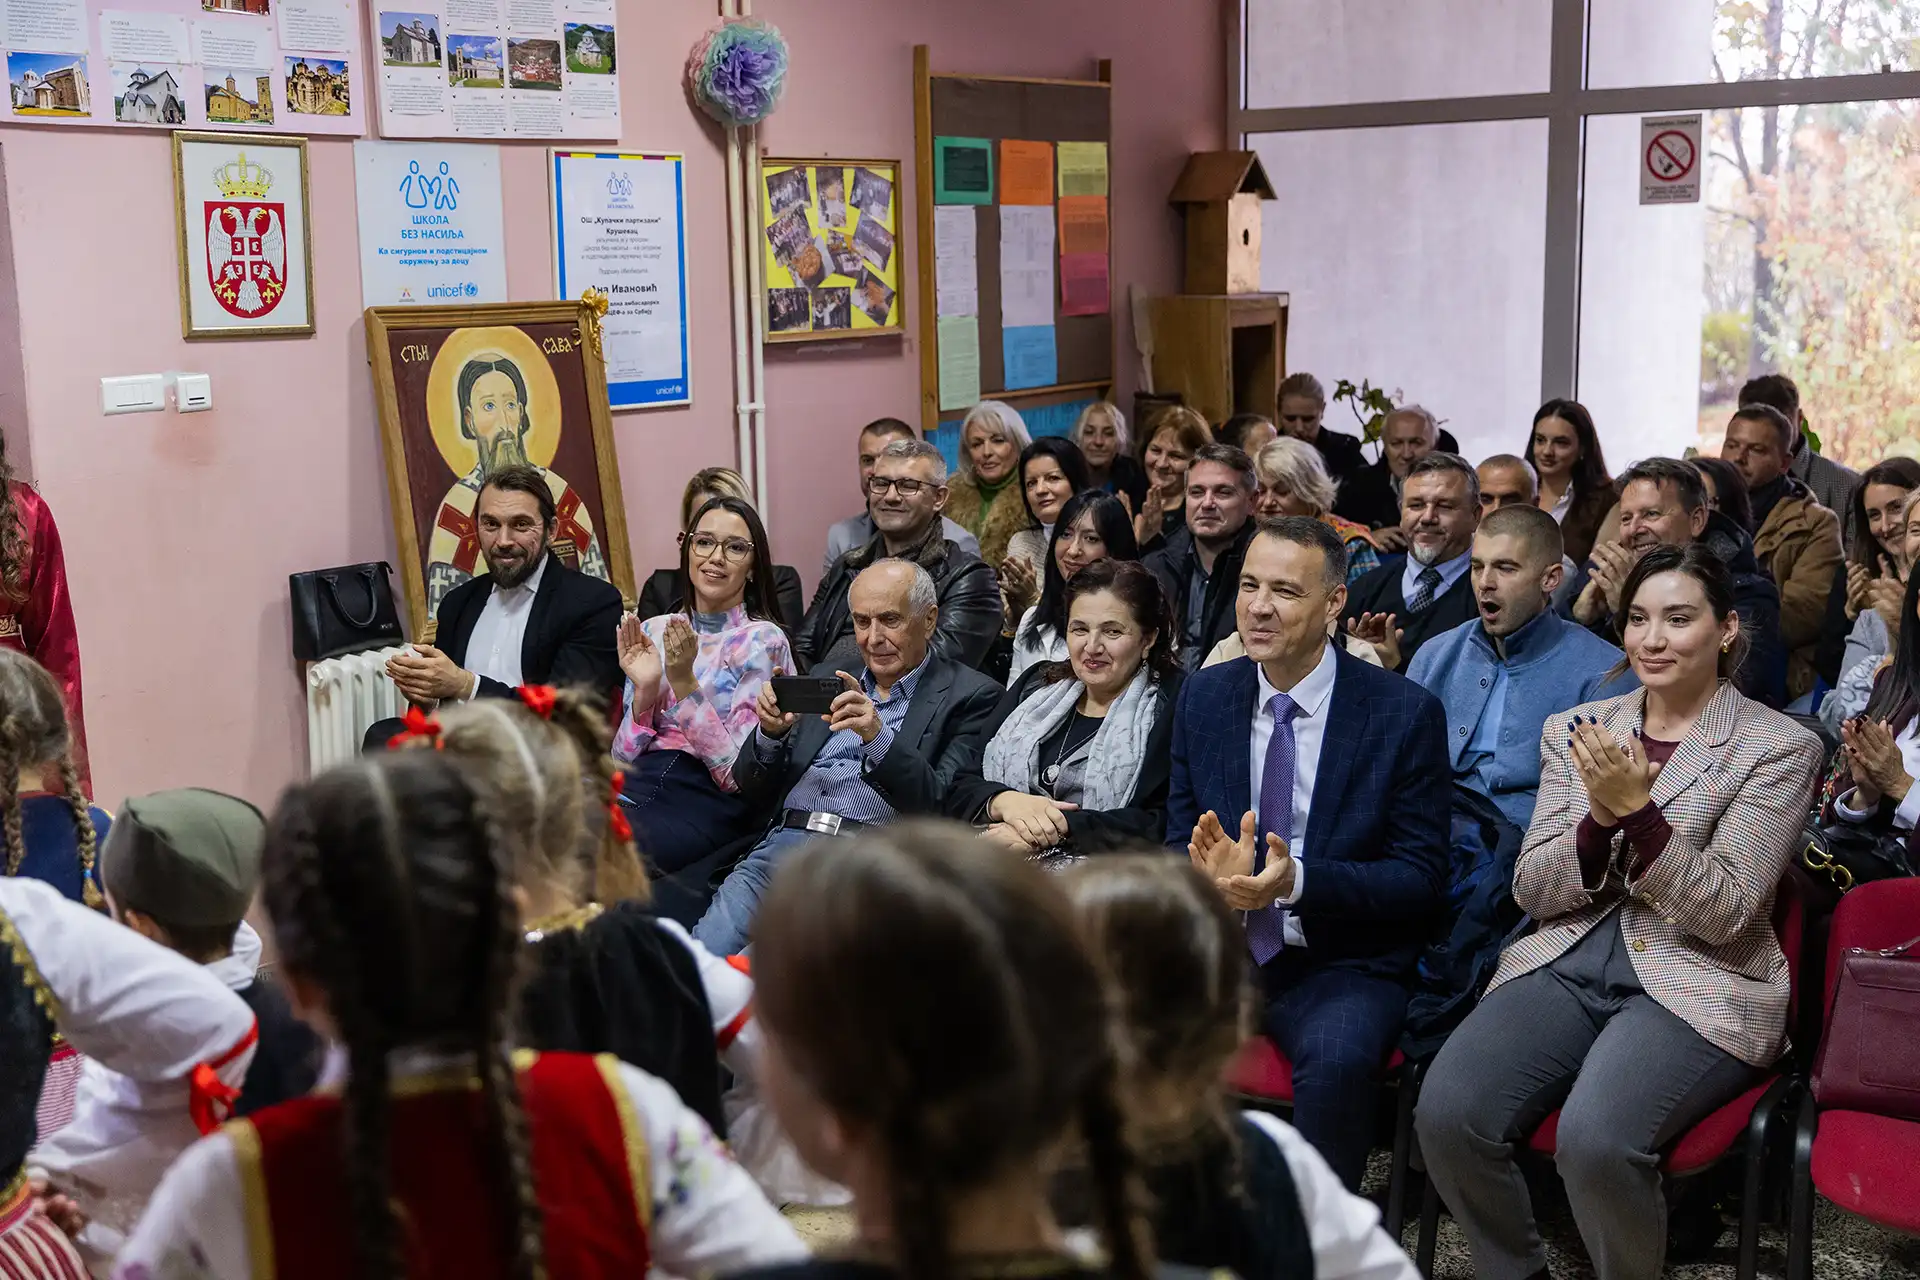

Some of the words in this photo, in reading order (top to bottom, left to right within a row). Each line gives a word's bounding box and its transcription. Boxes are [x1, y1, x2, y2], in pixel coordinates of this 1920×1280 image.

[412, 215, 450, 225] ШКОЛА
[401, 229, 419, 239] БЕЗ
[421, 229, 464, 239] НАСИЉА
[427, 282, 463, 298] unicef
[592, 285, 609, 294] на
[611, 283, 657, 294] Ивановић
